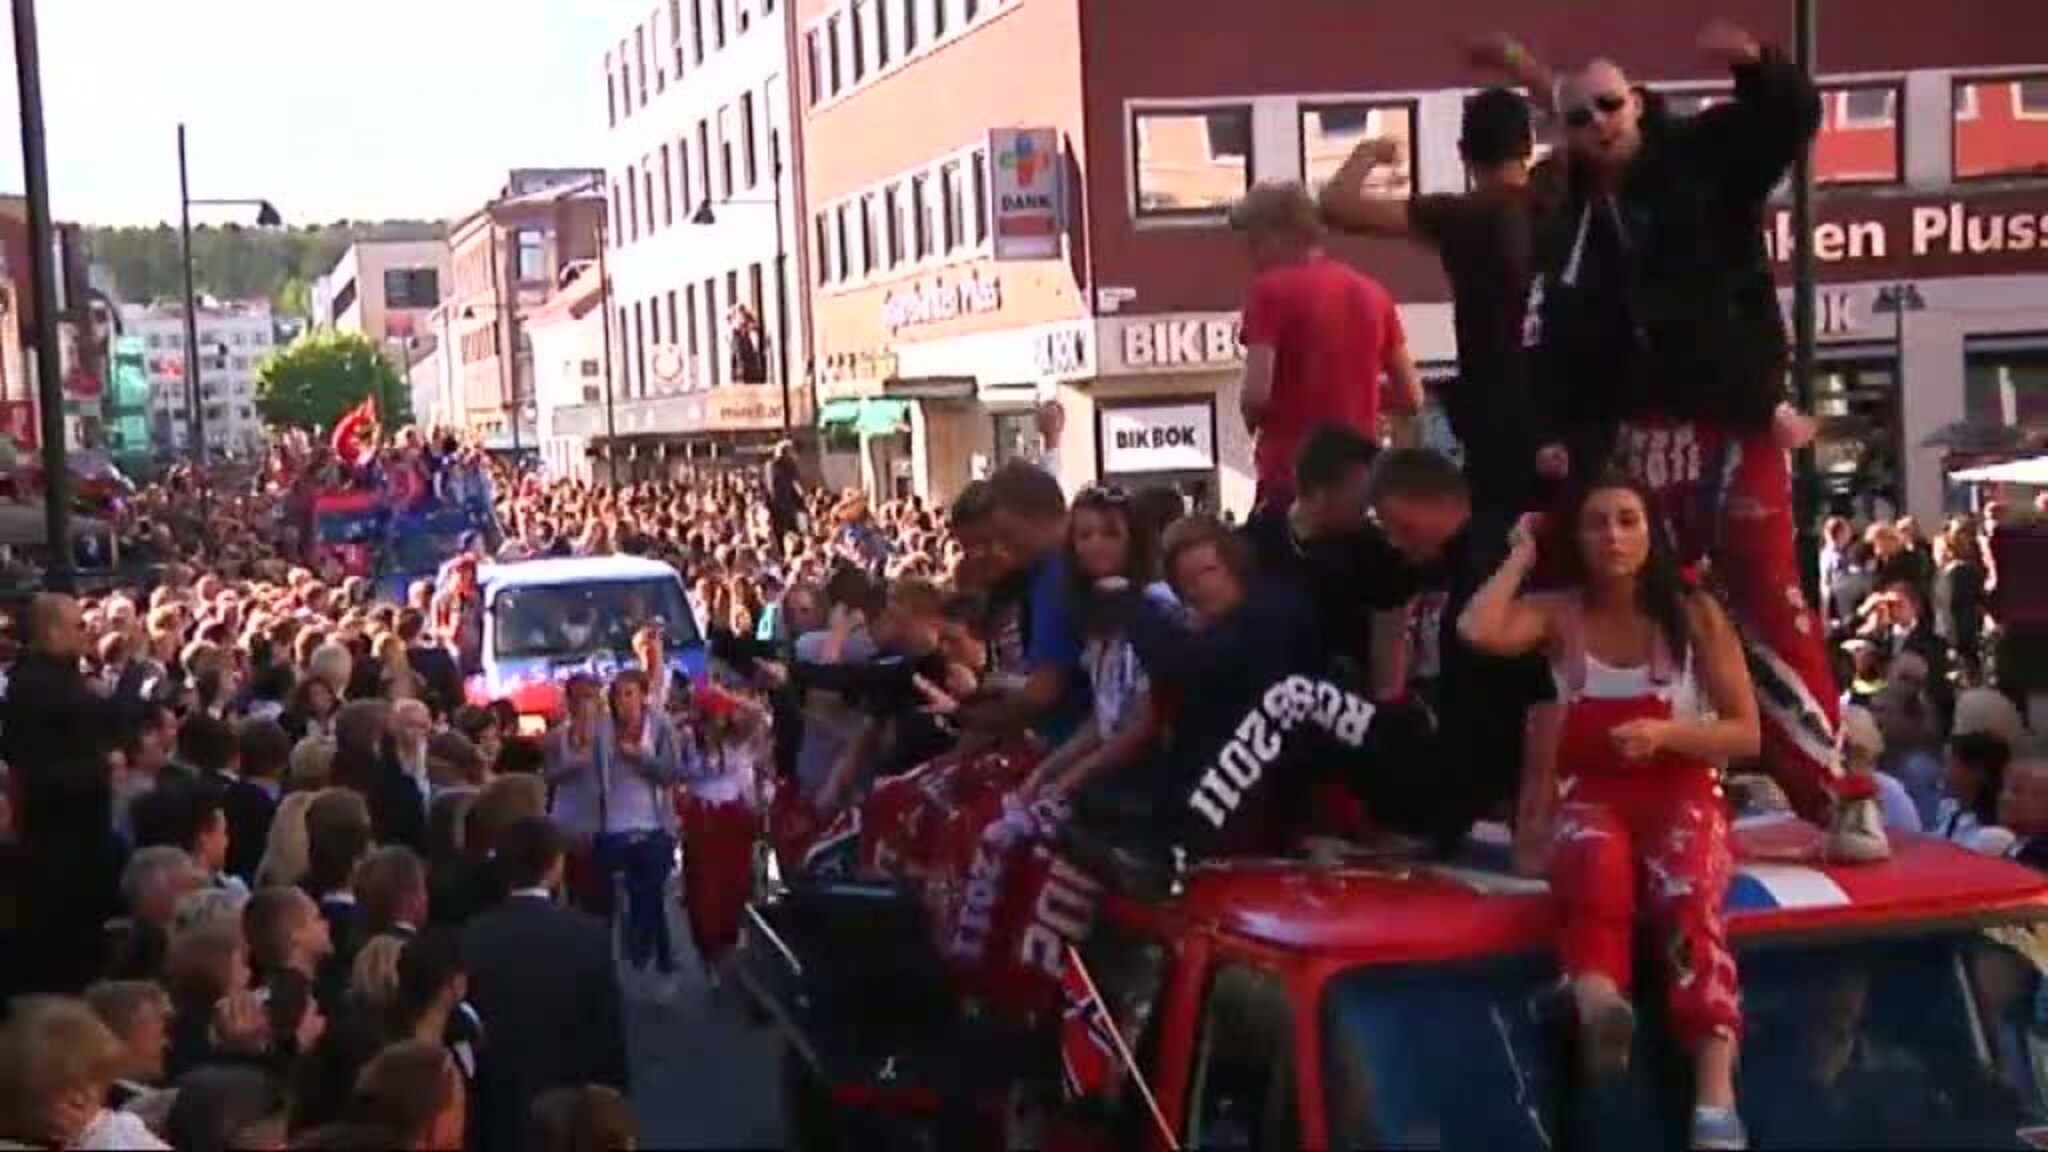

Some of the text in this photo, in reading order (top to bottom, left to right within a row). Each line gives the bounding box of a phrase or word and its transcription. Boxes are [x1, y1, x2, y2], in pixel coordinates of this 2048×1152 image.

[1912, 202, 2048, 255] Plus
[1125, 322, 1202, 364] BIK
[1117, 424, 1196, 449] BIK BOK
[1190, 709, 1281, 828] 2011
